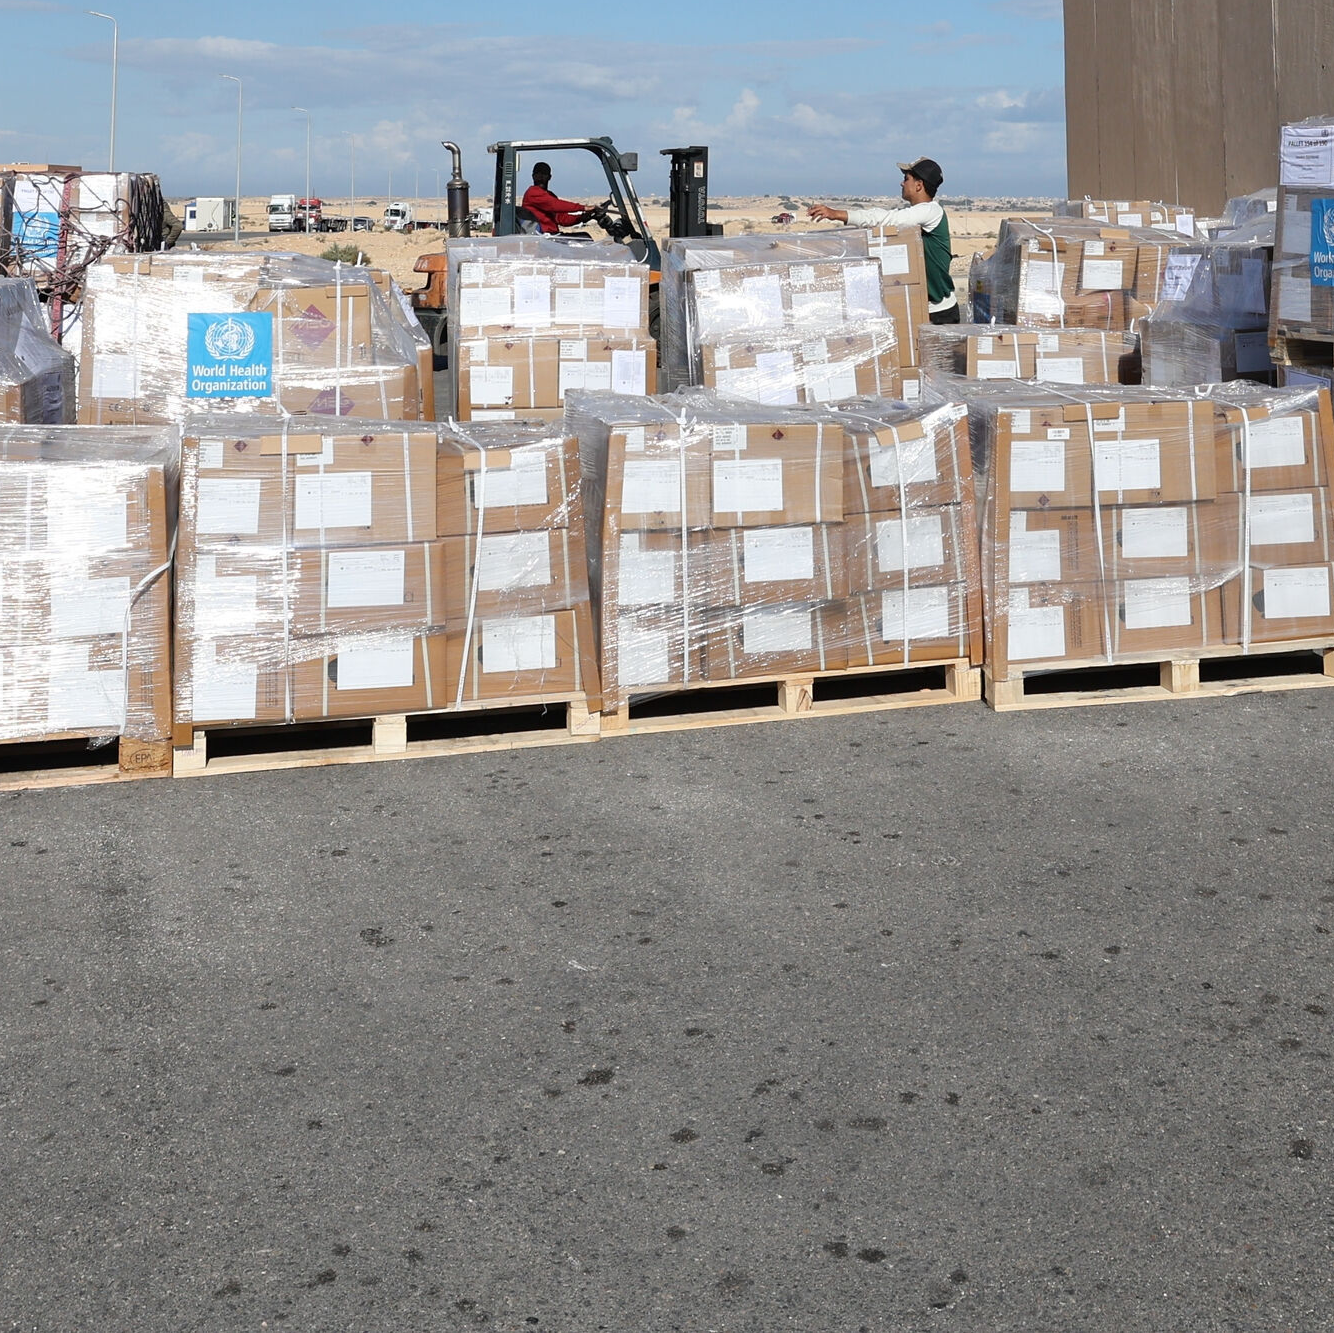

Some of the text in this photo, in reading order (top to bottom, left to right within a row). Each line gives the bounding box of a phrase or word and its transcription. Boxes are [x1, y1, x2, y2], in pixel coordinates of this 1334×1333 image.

[698, 186, 706, 224] TOYOTA
[192, 364, 267, 377] World Health
[192, 378, 267, 393] Organization
